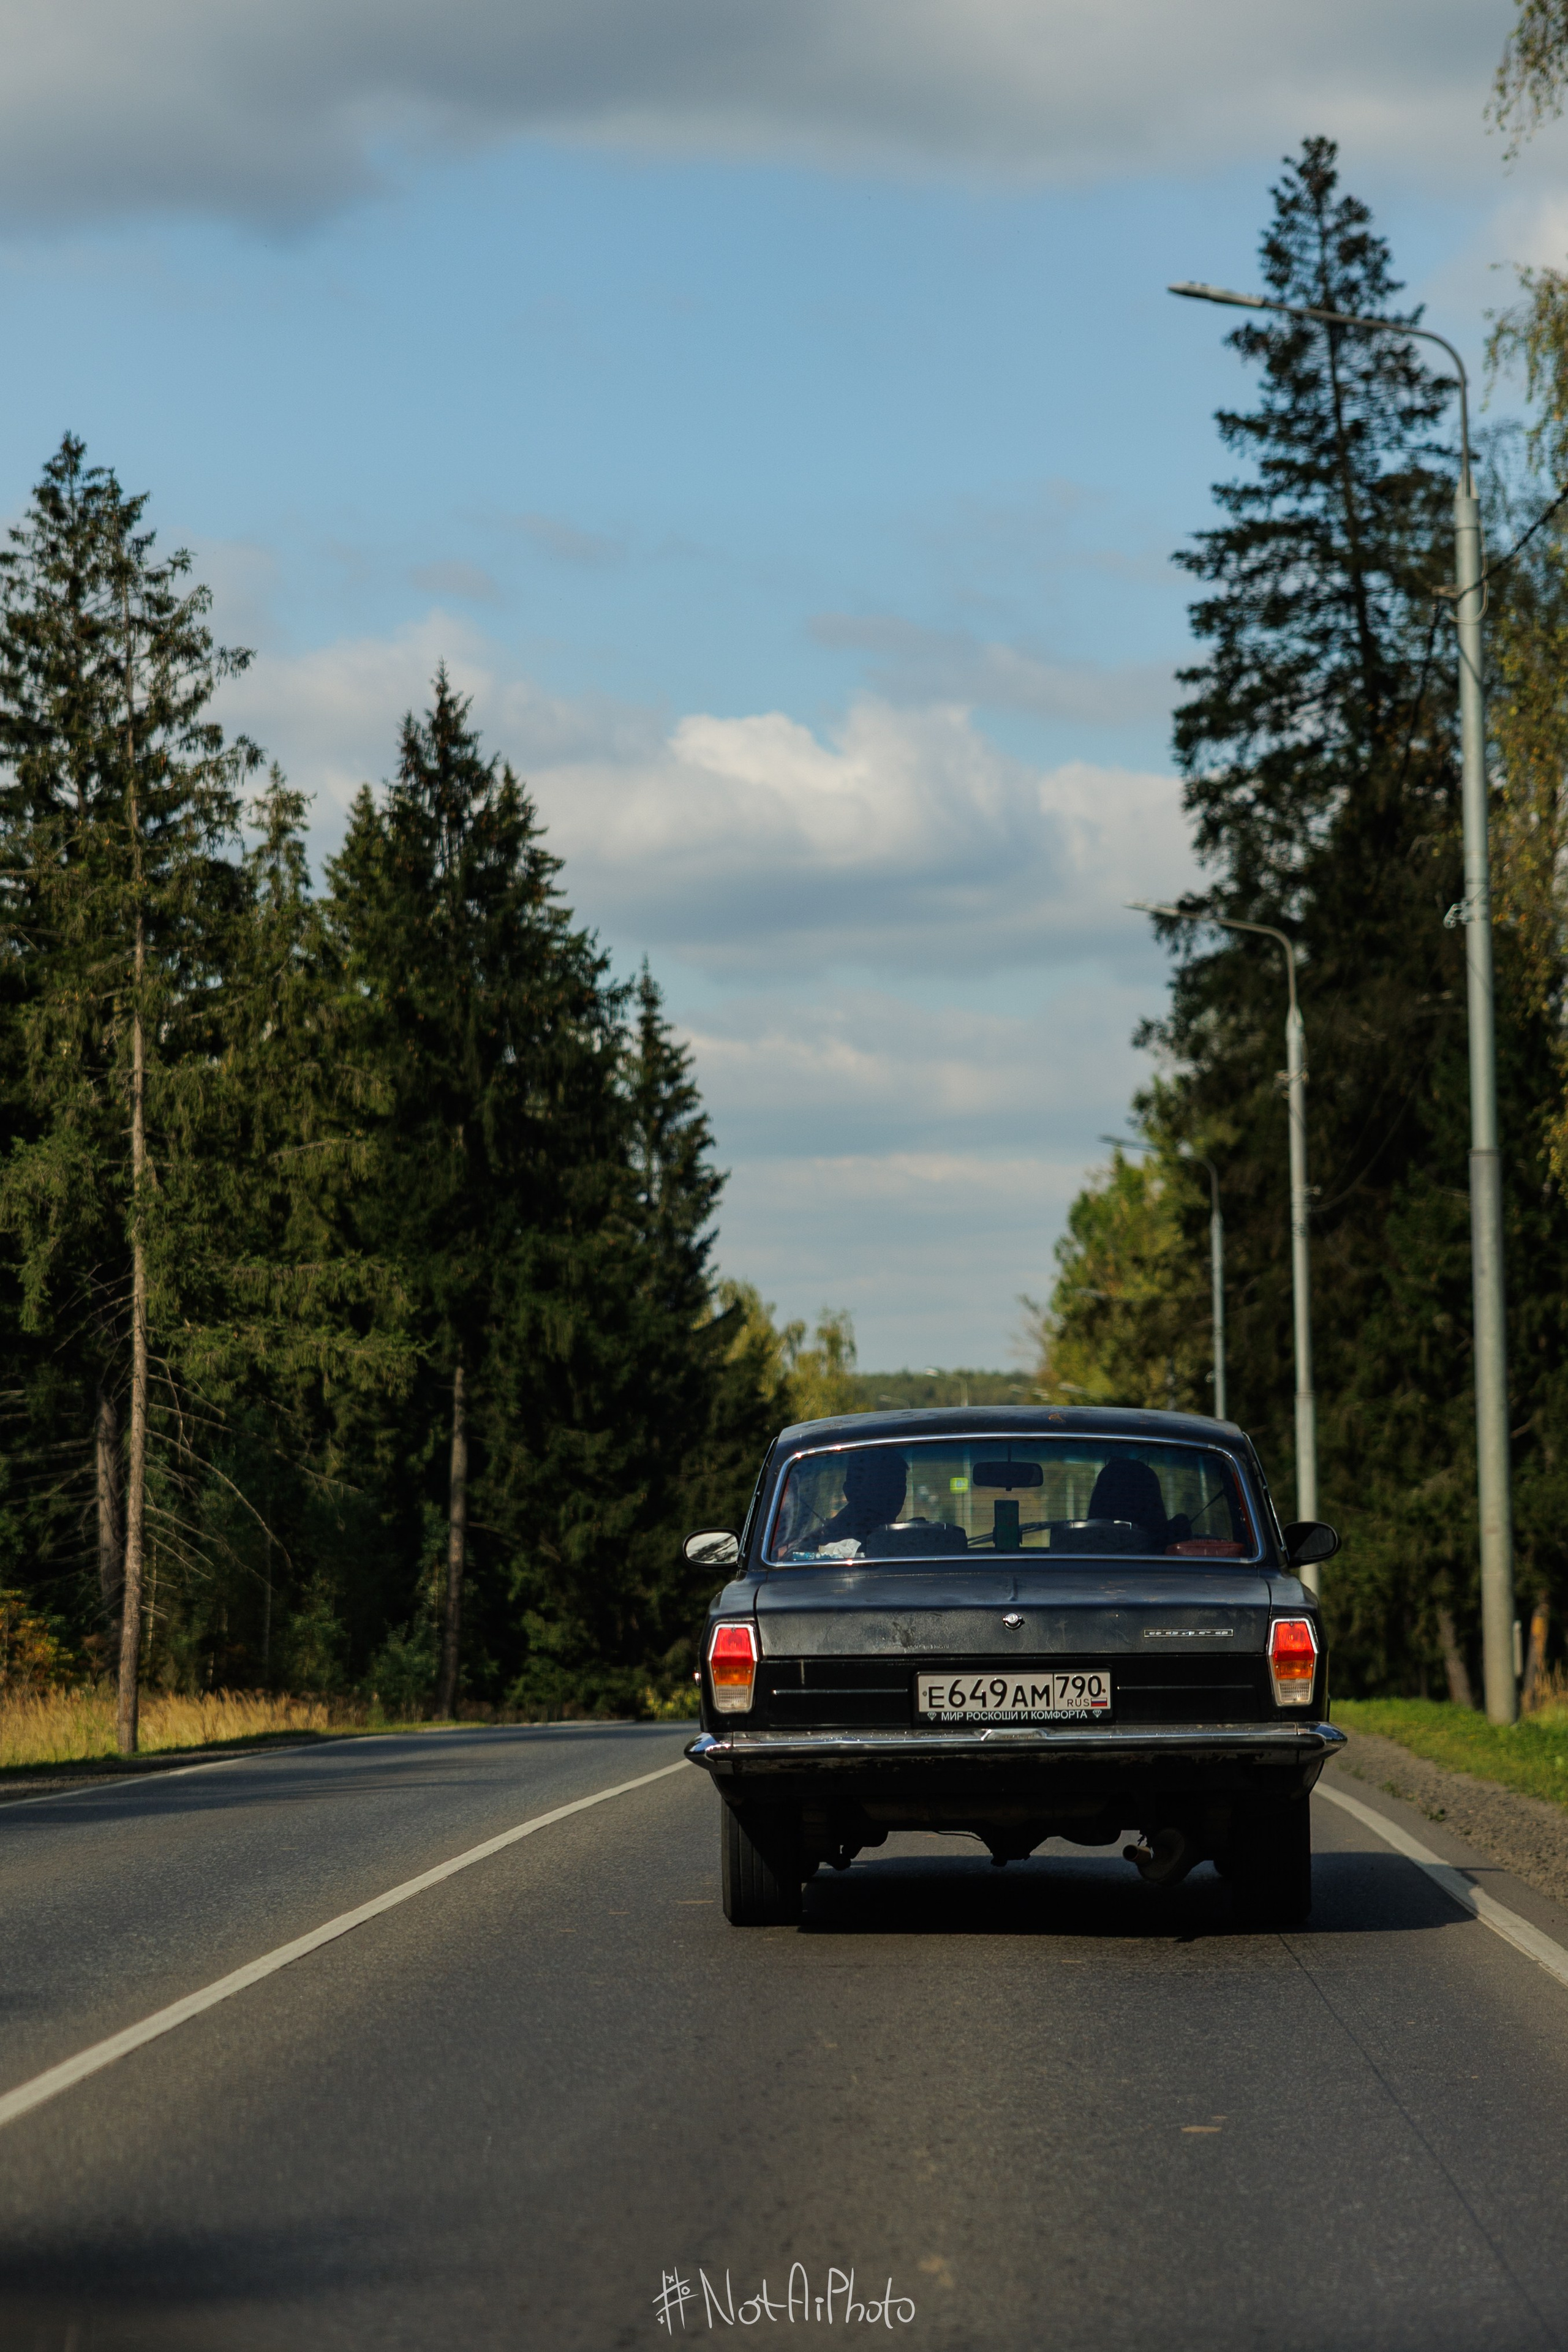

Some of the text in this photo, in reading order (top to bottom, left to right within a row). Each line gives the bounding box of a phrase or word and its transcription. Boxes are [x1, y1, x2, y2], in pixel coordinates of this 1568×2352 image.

[1055, 1675, 1102, 1698] 790
[1067, 1698, 1090, 1707] RUS
[941, 1709, 1088, 1721] МИР РОСКОШИ И КОМФОРТА
